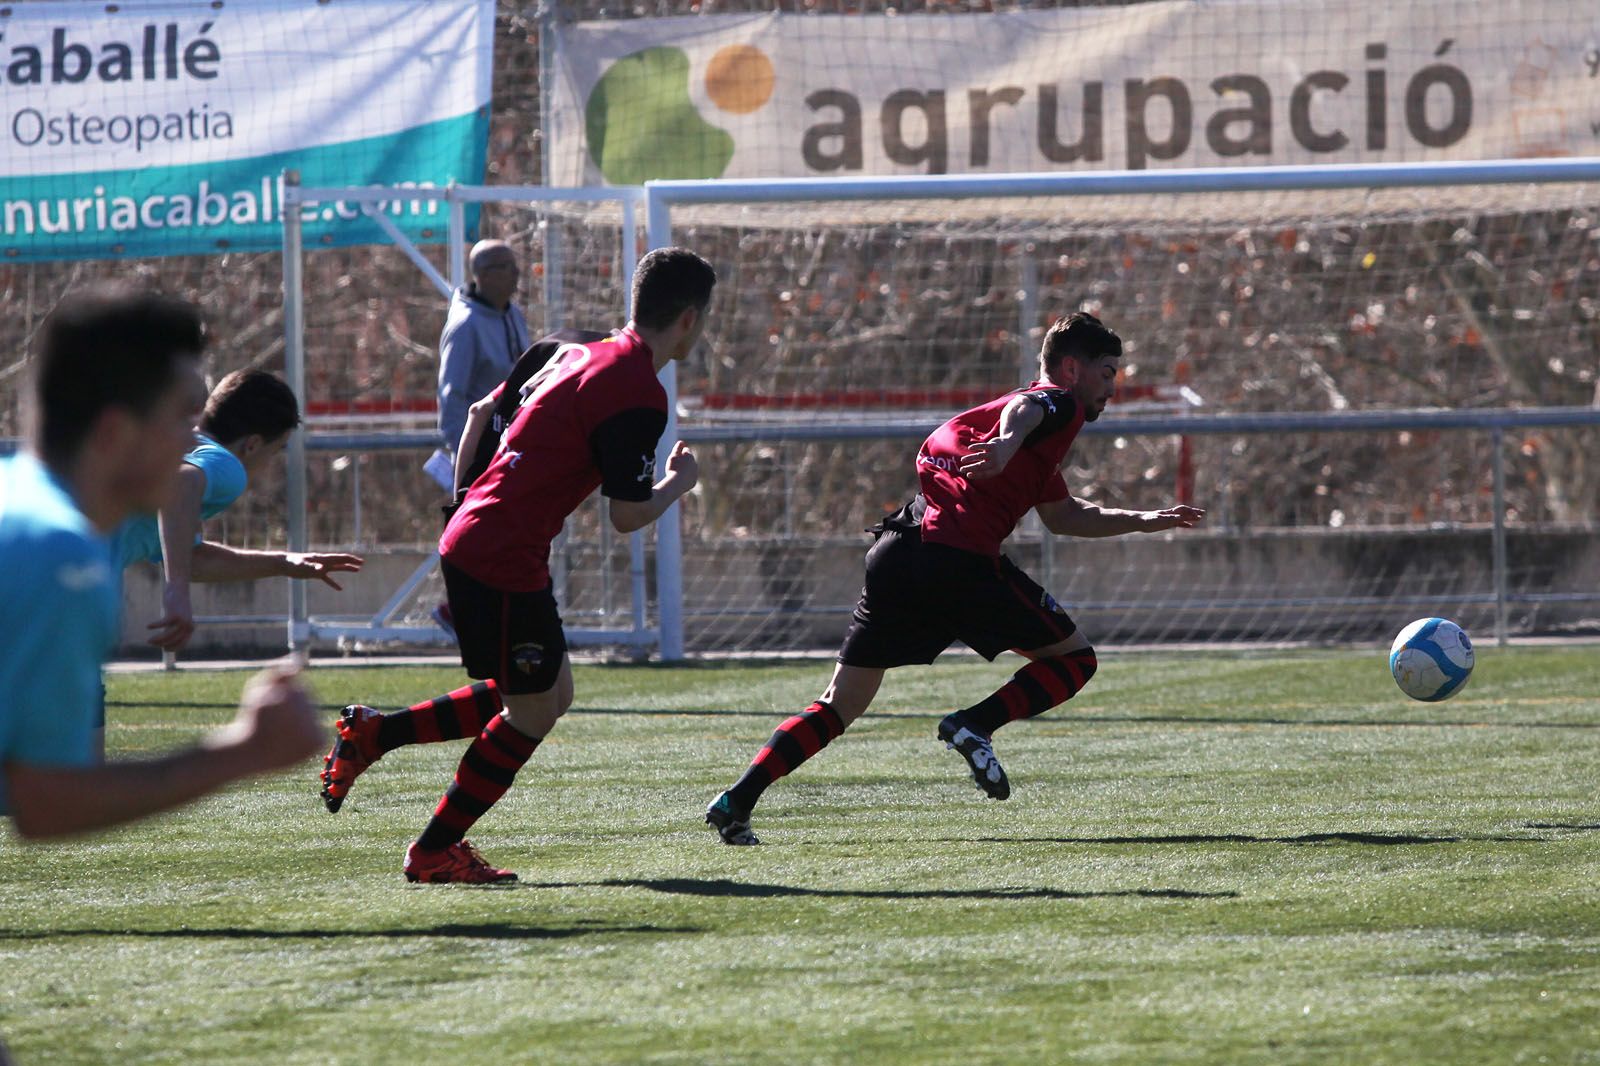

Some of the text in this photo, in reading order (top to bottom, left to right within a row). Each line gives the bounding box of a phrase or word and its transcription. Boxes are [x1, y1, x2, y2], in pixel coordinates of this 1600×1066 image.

[0, 22, 221, 85] aballé
[12, 103, 234, 152] Osteopatia
[802, 38, 1474, 174] agrupació
